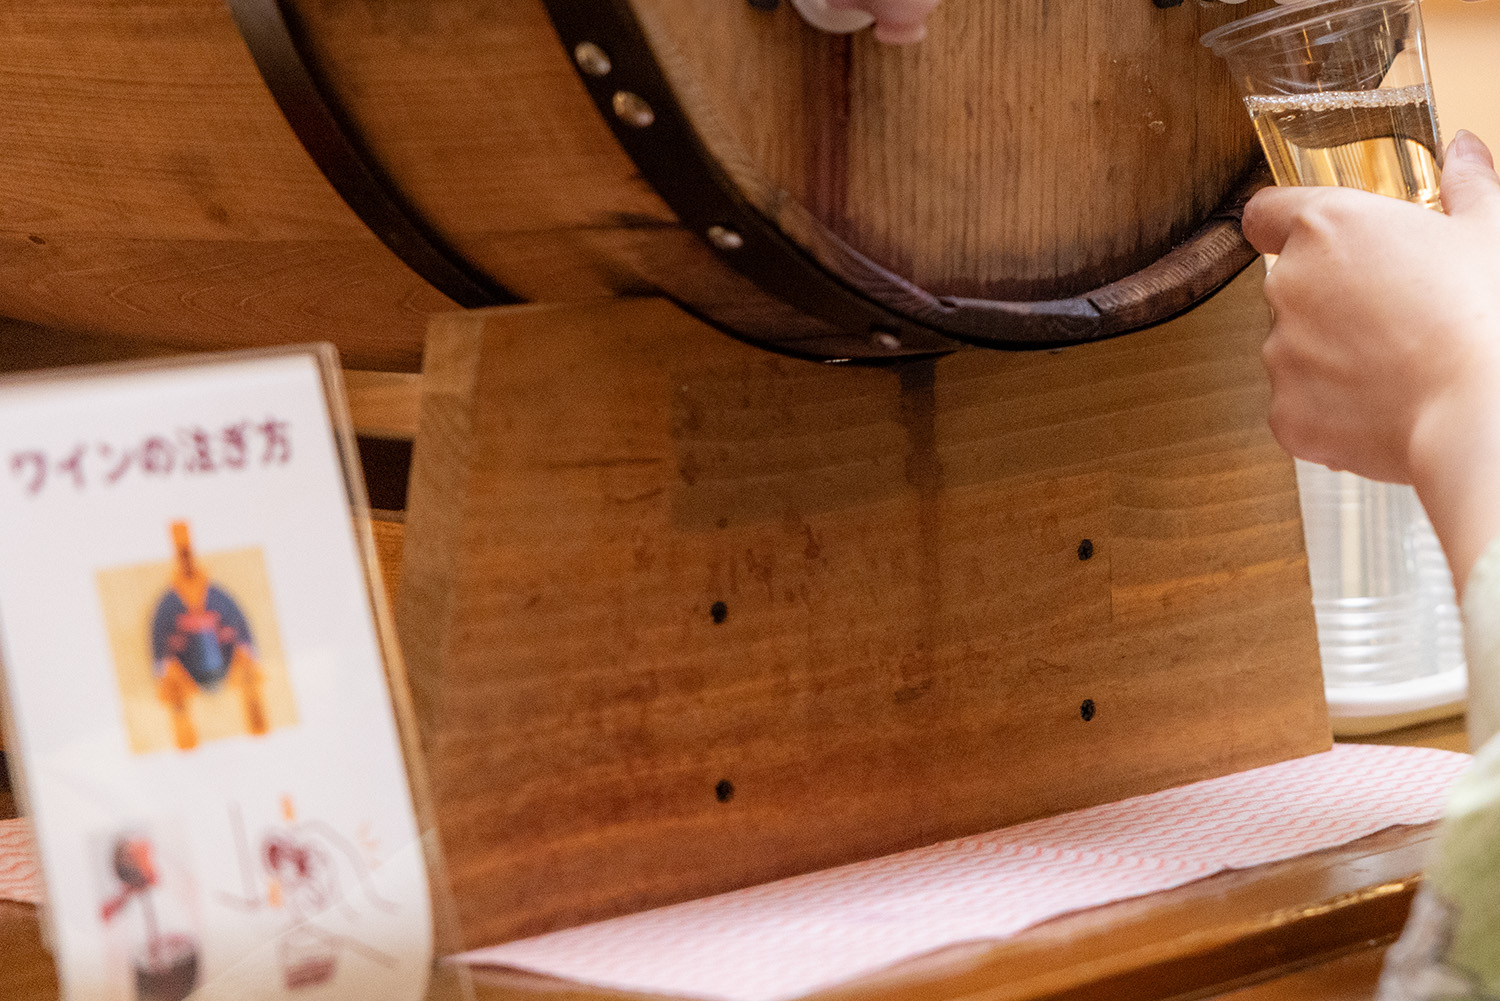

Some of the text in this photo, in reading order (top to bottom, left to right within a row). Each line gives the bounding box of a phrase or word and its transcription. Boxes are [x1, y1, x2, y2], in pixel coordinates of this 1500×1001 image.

[10, 417, 294, 495] ワインの注ぎ方
